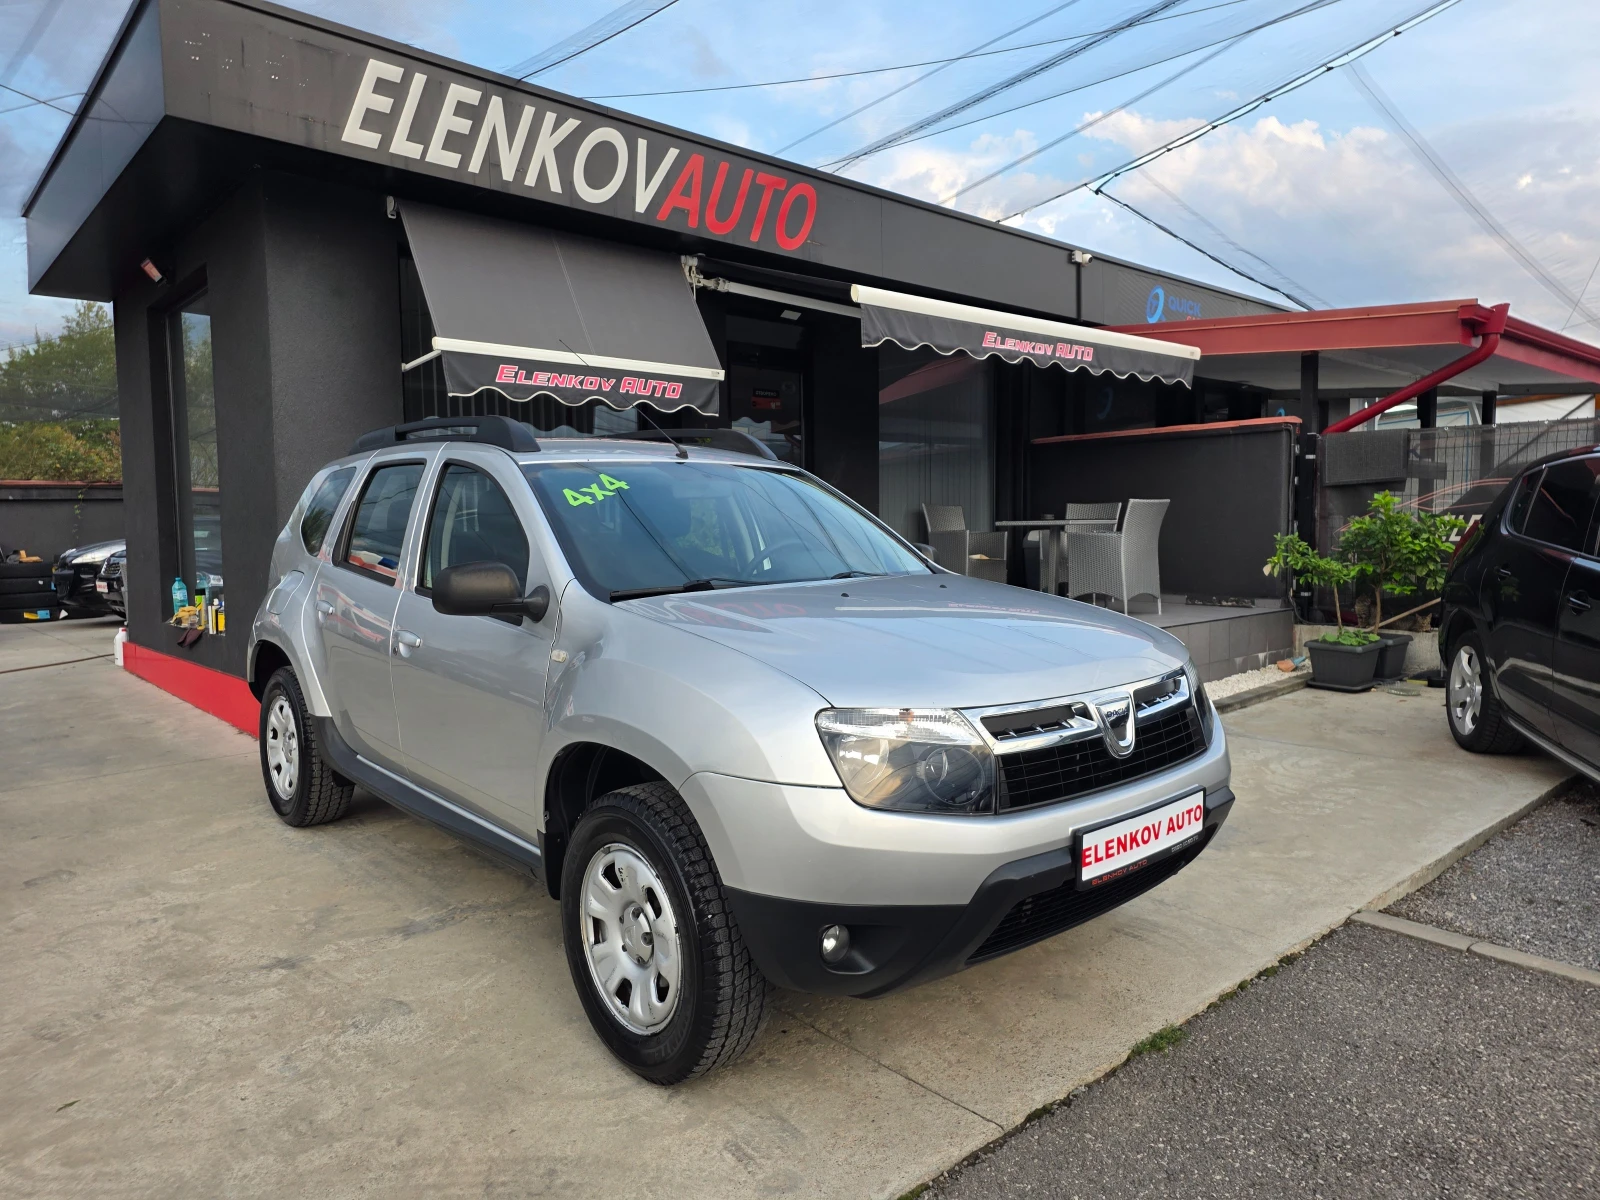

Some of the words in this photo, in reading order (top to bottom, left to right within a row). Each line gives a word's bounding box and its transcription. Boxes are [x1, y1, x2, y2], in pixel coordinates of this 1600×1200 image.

[1168, 296, 1201, 317] QUICK
[983, 332, 1054, 356] ELENKOV
[1055, 343, 1094, 361] AUTO
[496, 365, 616, 391] ELENKOV
[620, 377, 682, 398] AUTO
[1082, 821, 1161, 868] ELENKOV
[1166, 805, 1203, 835] AUTO
